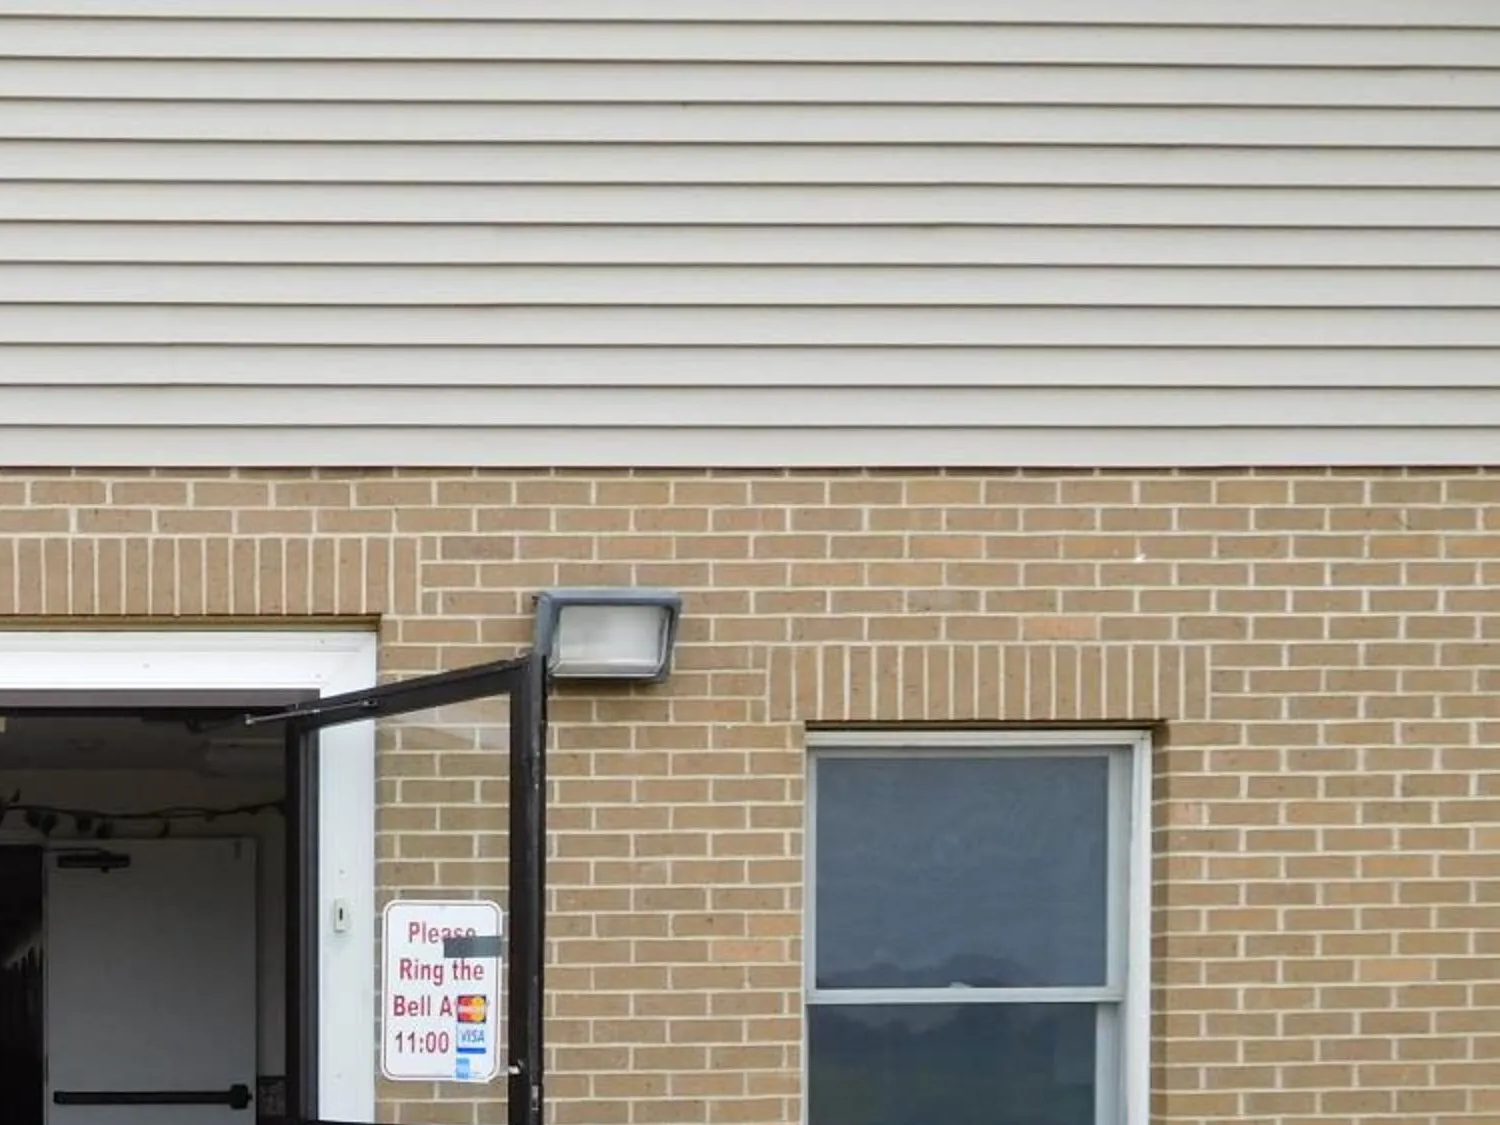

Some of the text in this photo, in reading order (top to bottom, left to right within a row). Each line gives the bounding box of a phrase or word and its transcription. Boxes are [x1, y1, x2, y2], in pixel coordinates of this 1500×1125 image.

[399, 958, 484, 987] Ring the
[393, 995, 431, 1017] Bell
[439, 995, 456, 1017] A
[394, 1031, 450, 1054] 11:00
[460, 1029, 485, 1043] VISA
